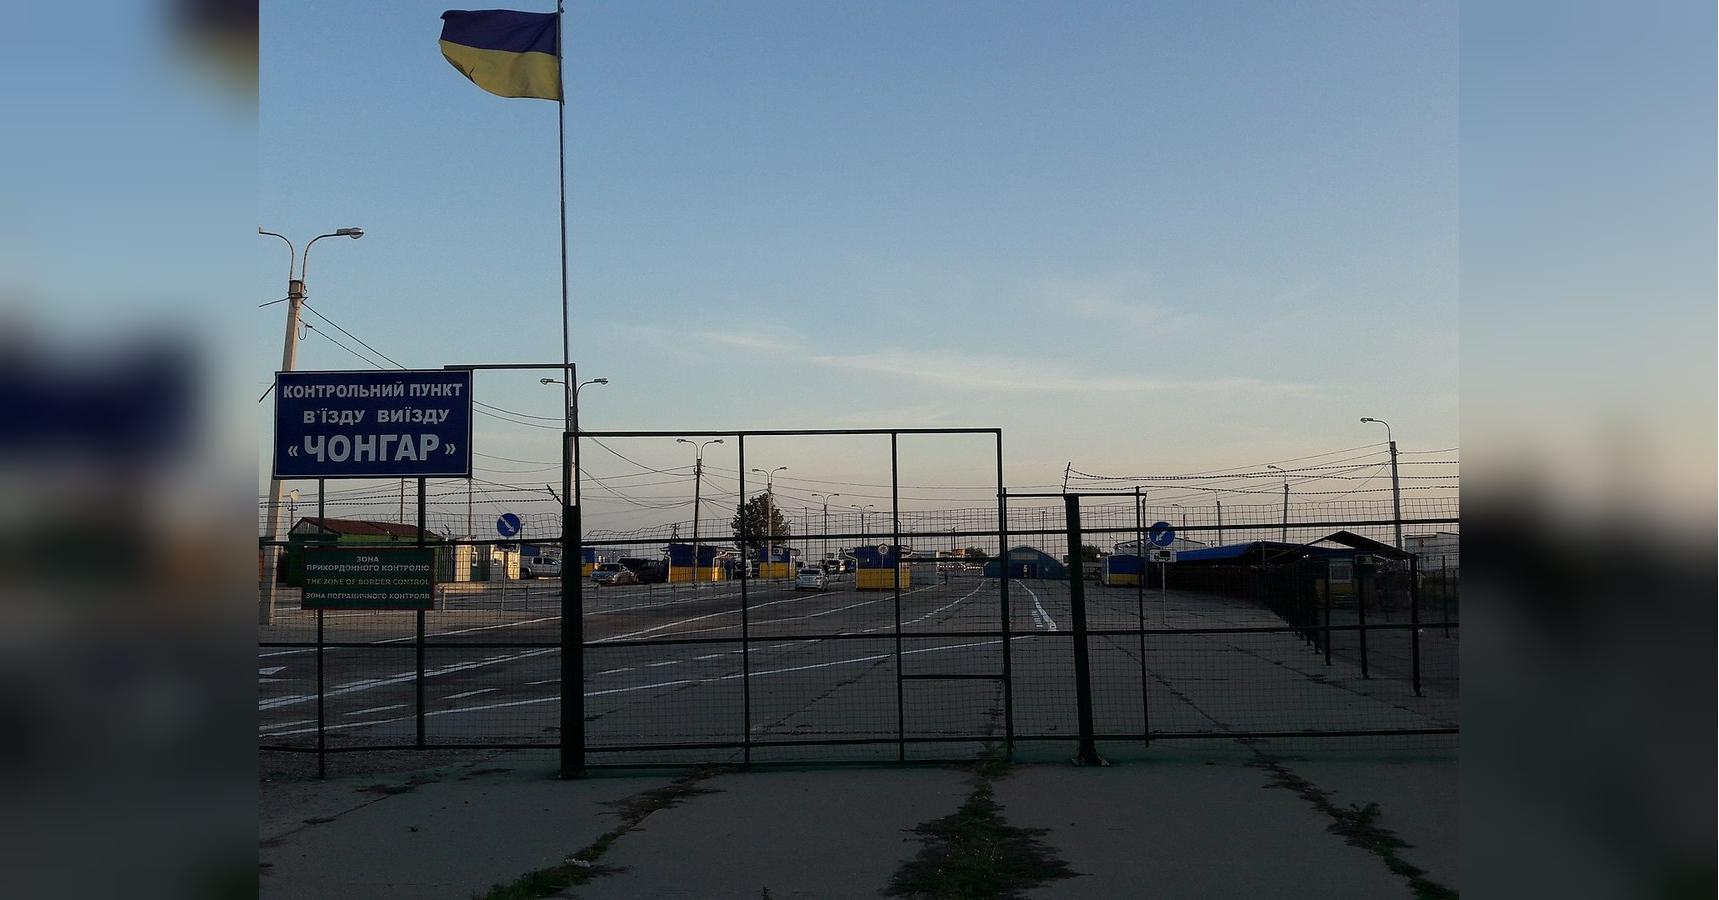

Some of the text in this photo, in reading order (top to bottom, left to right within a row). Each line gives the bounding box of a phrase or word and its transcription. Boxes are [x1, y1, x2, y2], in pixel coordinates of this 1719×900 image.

[283, 381, 463, 398] КОНТРОЛЬНИЙ ПУНКТ
[377, 406, 450, 425] ВИЇЗДУ
[306, 564, 430, 572] ПРИКОРДОННОГО КОНТРОЛЮ
[327, 592, 387, 600] ПОГРАНИЧНОГО
[389, 592, 430, 600] КОНТРОЛЯ
